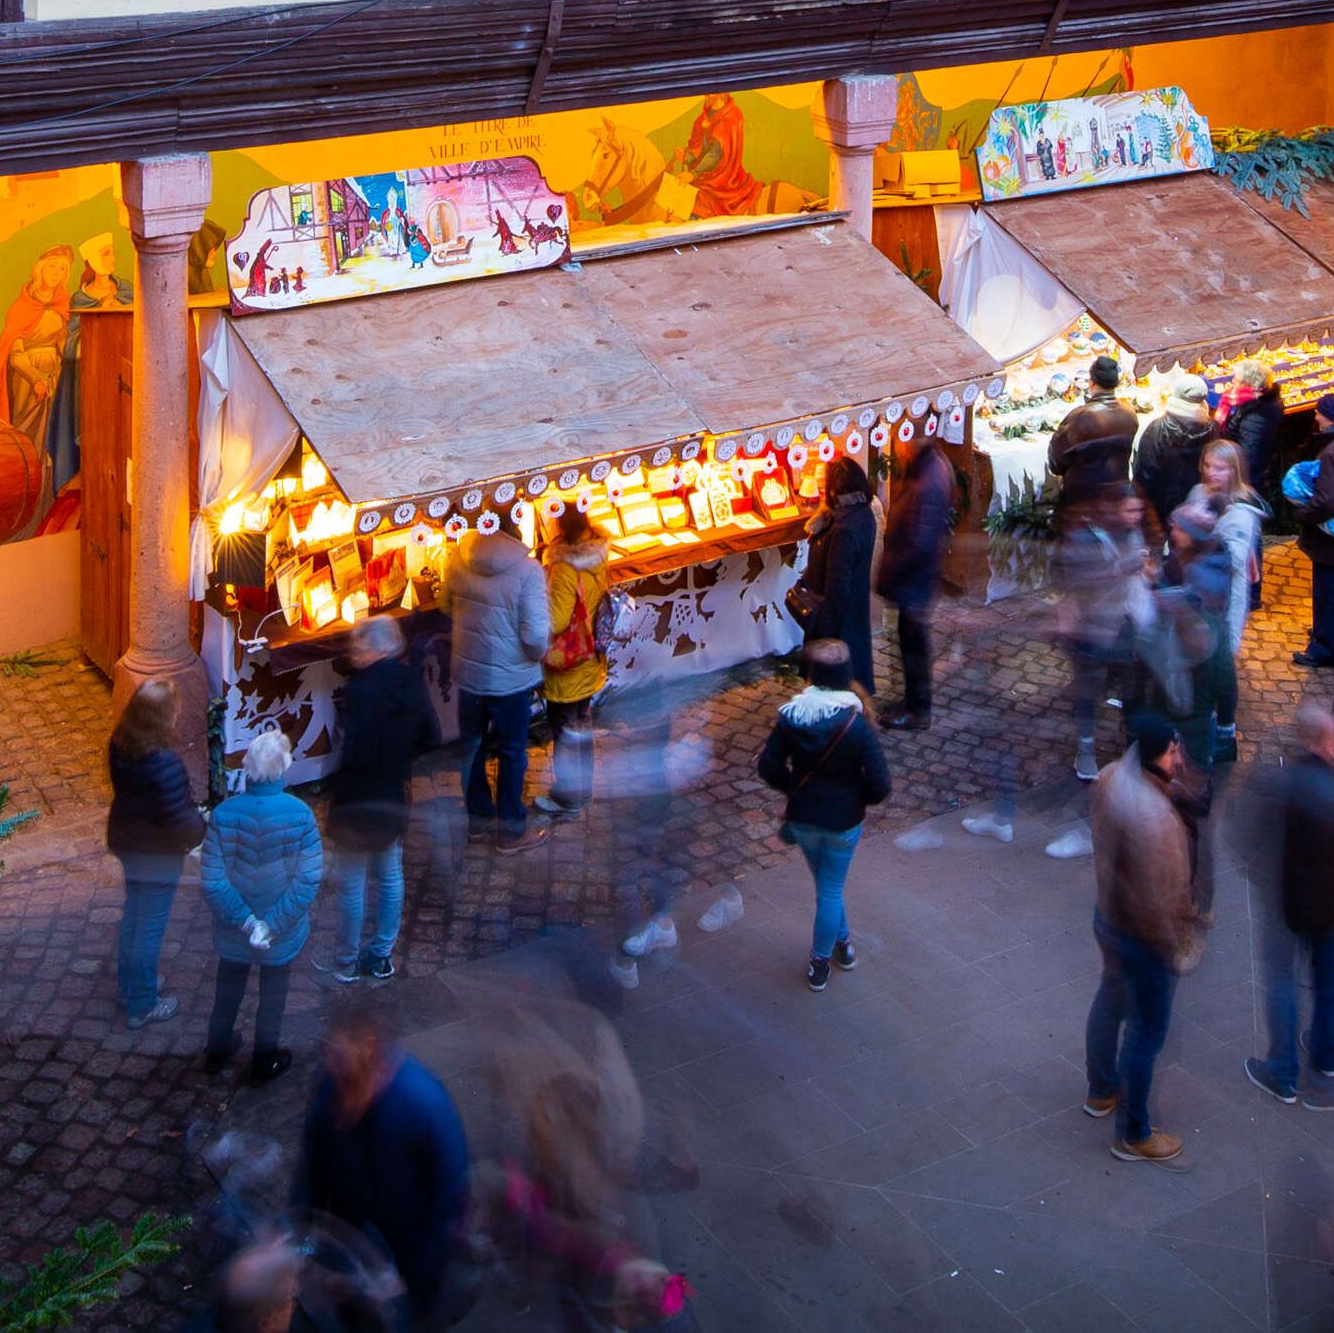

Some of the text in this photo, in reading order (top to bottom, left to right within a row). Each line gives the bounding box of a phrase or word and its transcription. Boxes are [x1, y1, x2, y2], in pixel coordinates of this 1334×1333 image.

[443, 124, 462, 137] LE
[517, 116, 536, 129] DE
[429, 134, 547, 159] VILLE D'EMPIRE
